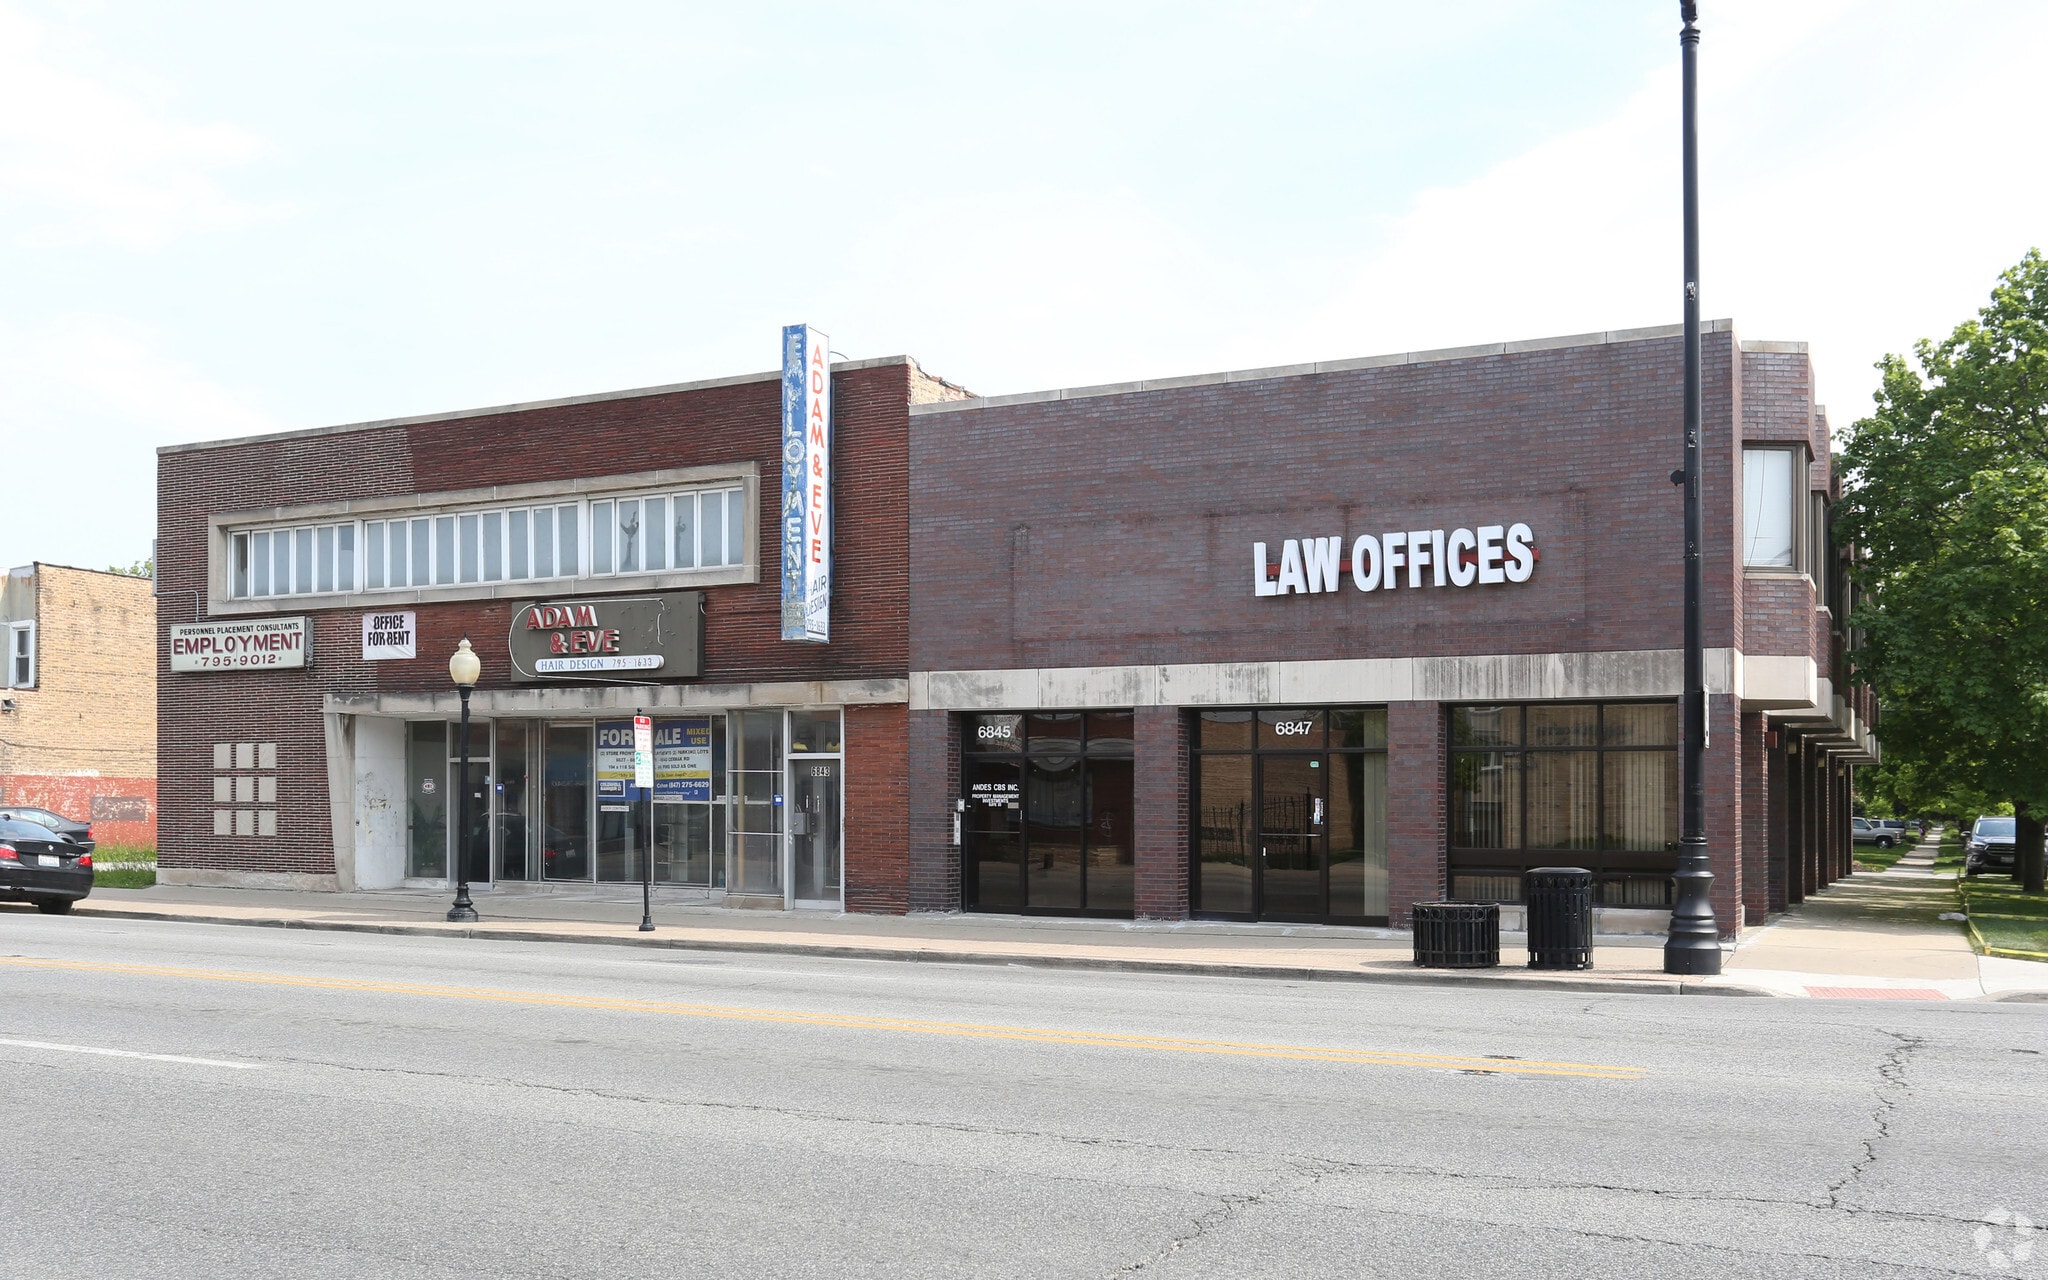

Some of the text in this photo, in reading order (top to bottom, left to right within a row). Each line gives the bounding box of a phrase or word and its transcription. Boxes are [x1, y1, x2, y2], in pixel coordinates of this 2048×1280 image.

[810, 344, 824, 563] ADAM & EVE
[1253, 523, 1534, 596] LAW OFFICES
[373, 615, 404, 630] OFFICE
[526, 605, 598, 630] ADAM
[180, 622, 299, 635] PERSONNEL PLACEMENT CONSULTANTS
[173, 632, 302, 655] EMPLOYMENT
[368, 630, 410, 646] FOR RENT
[550, 629, 619, 654] & EVE
[541, 659, 565, 670] HAIR
[569, 658, 604, 669] DESIGN
[978, 725, 1011, 738] 6845
[1275, 721, 1312, 735] 6847
[600, 730, 633, 746] FOR
[655, 728, 681, 745] ALE
[811, 766, 830, 776] 6843
